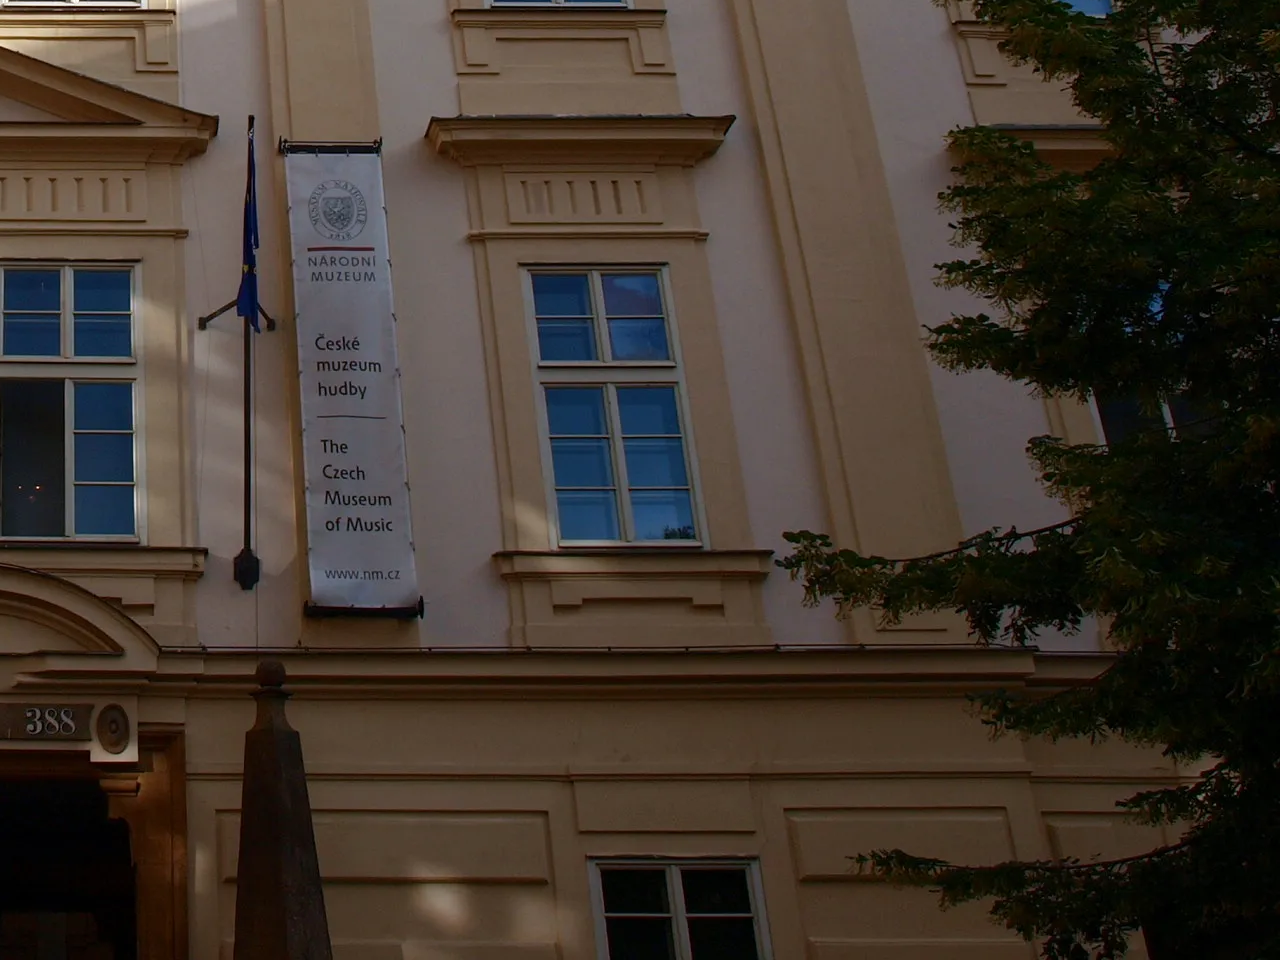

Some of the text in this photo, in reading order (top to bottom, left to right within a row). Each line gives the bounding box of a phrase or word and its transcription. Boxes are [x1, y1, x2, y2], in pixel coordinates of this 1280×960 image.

[307, 255, 376, 267] NÁRODNÍ
[311, 271, 376, 282] MUZEUM
[315, 333, 360, 351] České
[316, 360, 381, 373] muzeum
[318, 381, 367, 400] hudby
[321, 439, 348, 454] The
[323, 464, 365, 480] Czech
[324, 490, 392, 506] Museum
[325, 517, 393, 532] of Music
[324, 569, 400, 581] www.nm.cz
[24, 708, 76, 735] 388
